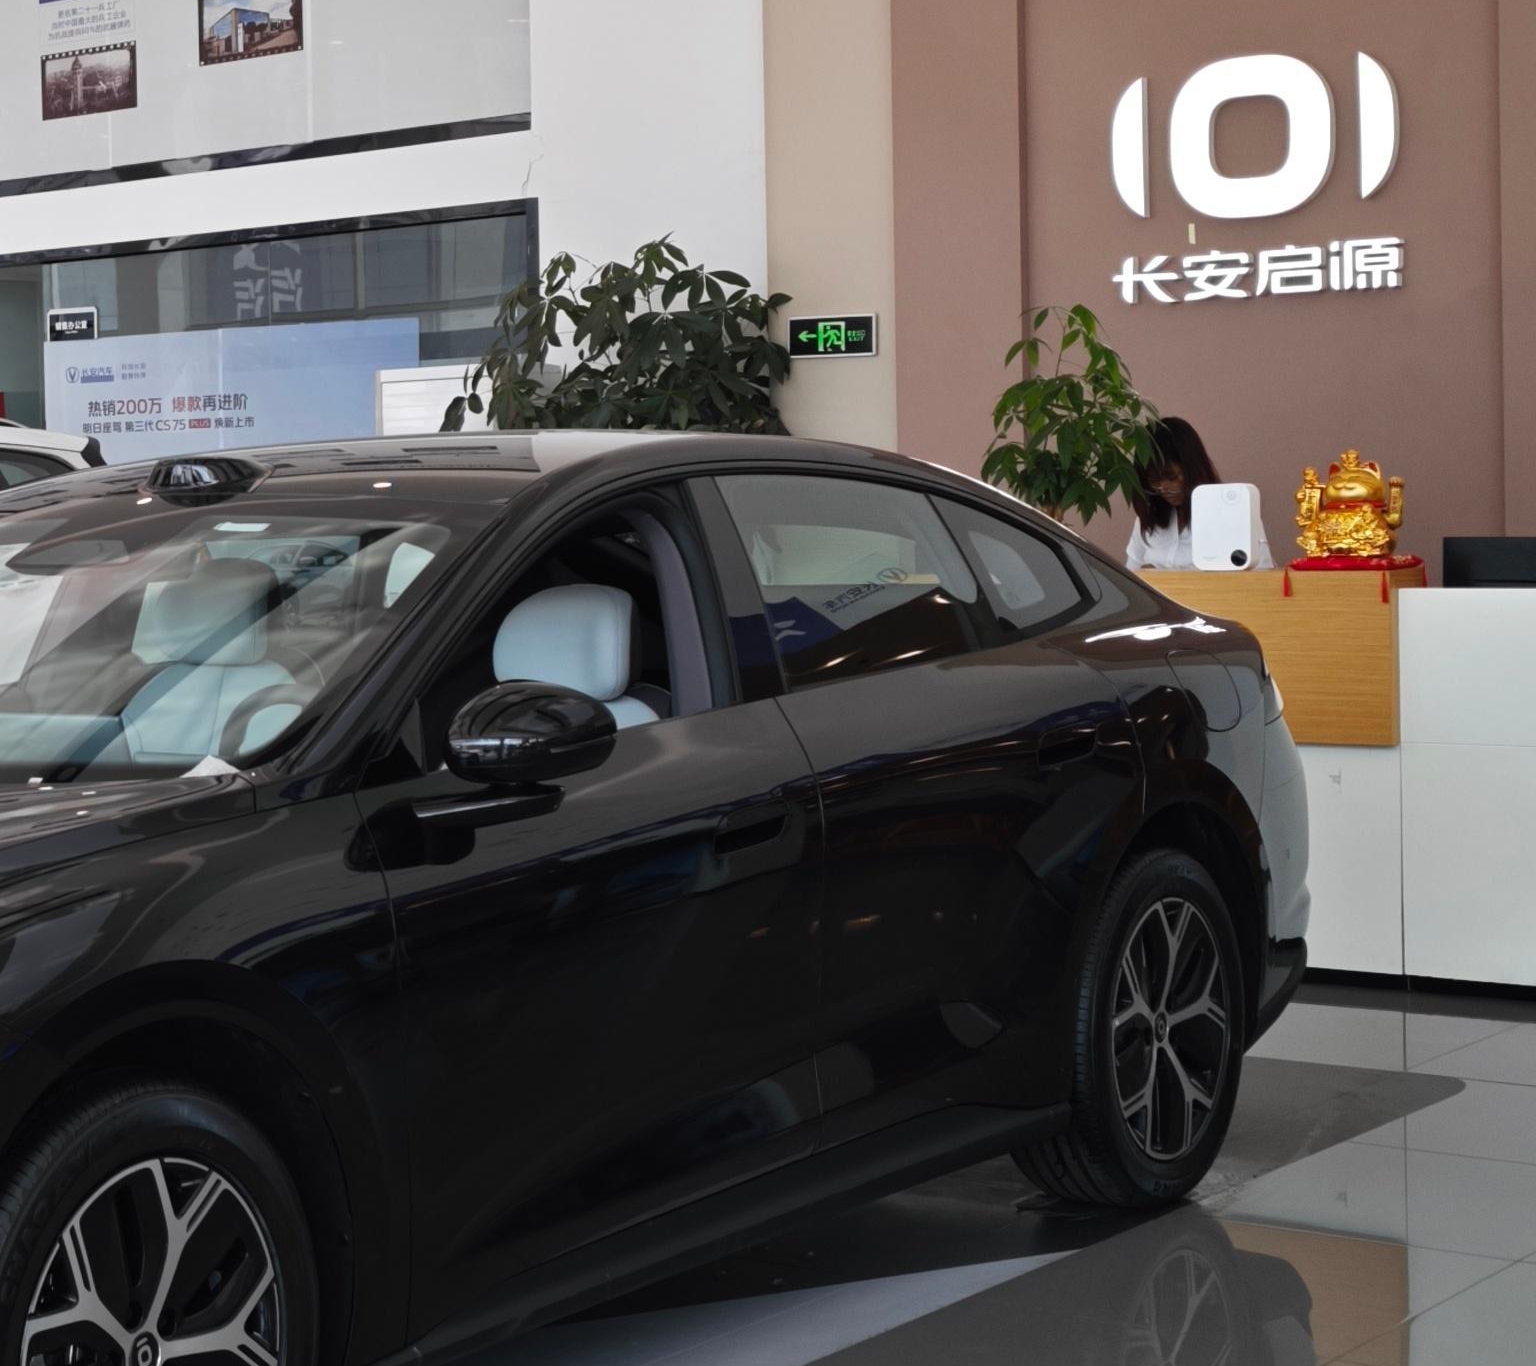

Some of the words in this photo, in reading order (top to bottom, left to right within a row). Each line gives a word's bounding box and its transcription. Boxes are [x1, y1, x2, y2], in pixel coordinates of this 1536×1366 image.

[1112, 237, 1405, 305] 长安启源
[88, 397, 162, 418] 热销200万
[171, 393, 249, 414] 爆款再进阶
[125, 419, 186, 433] 第三代CS75
